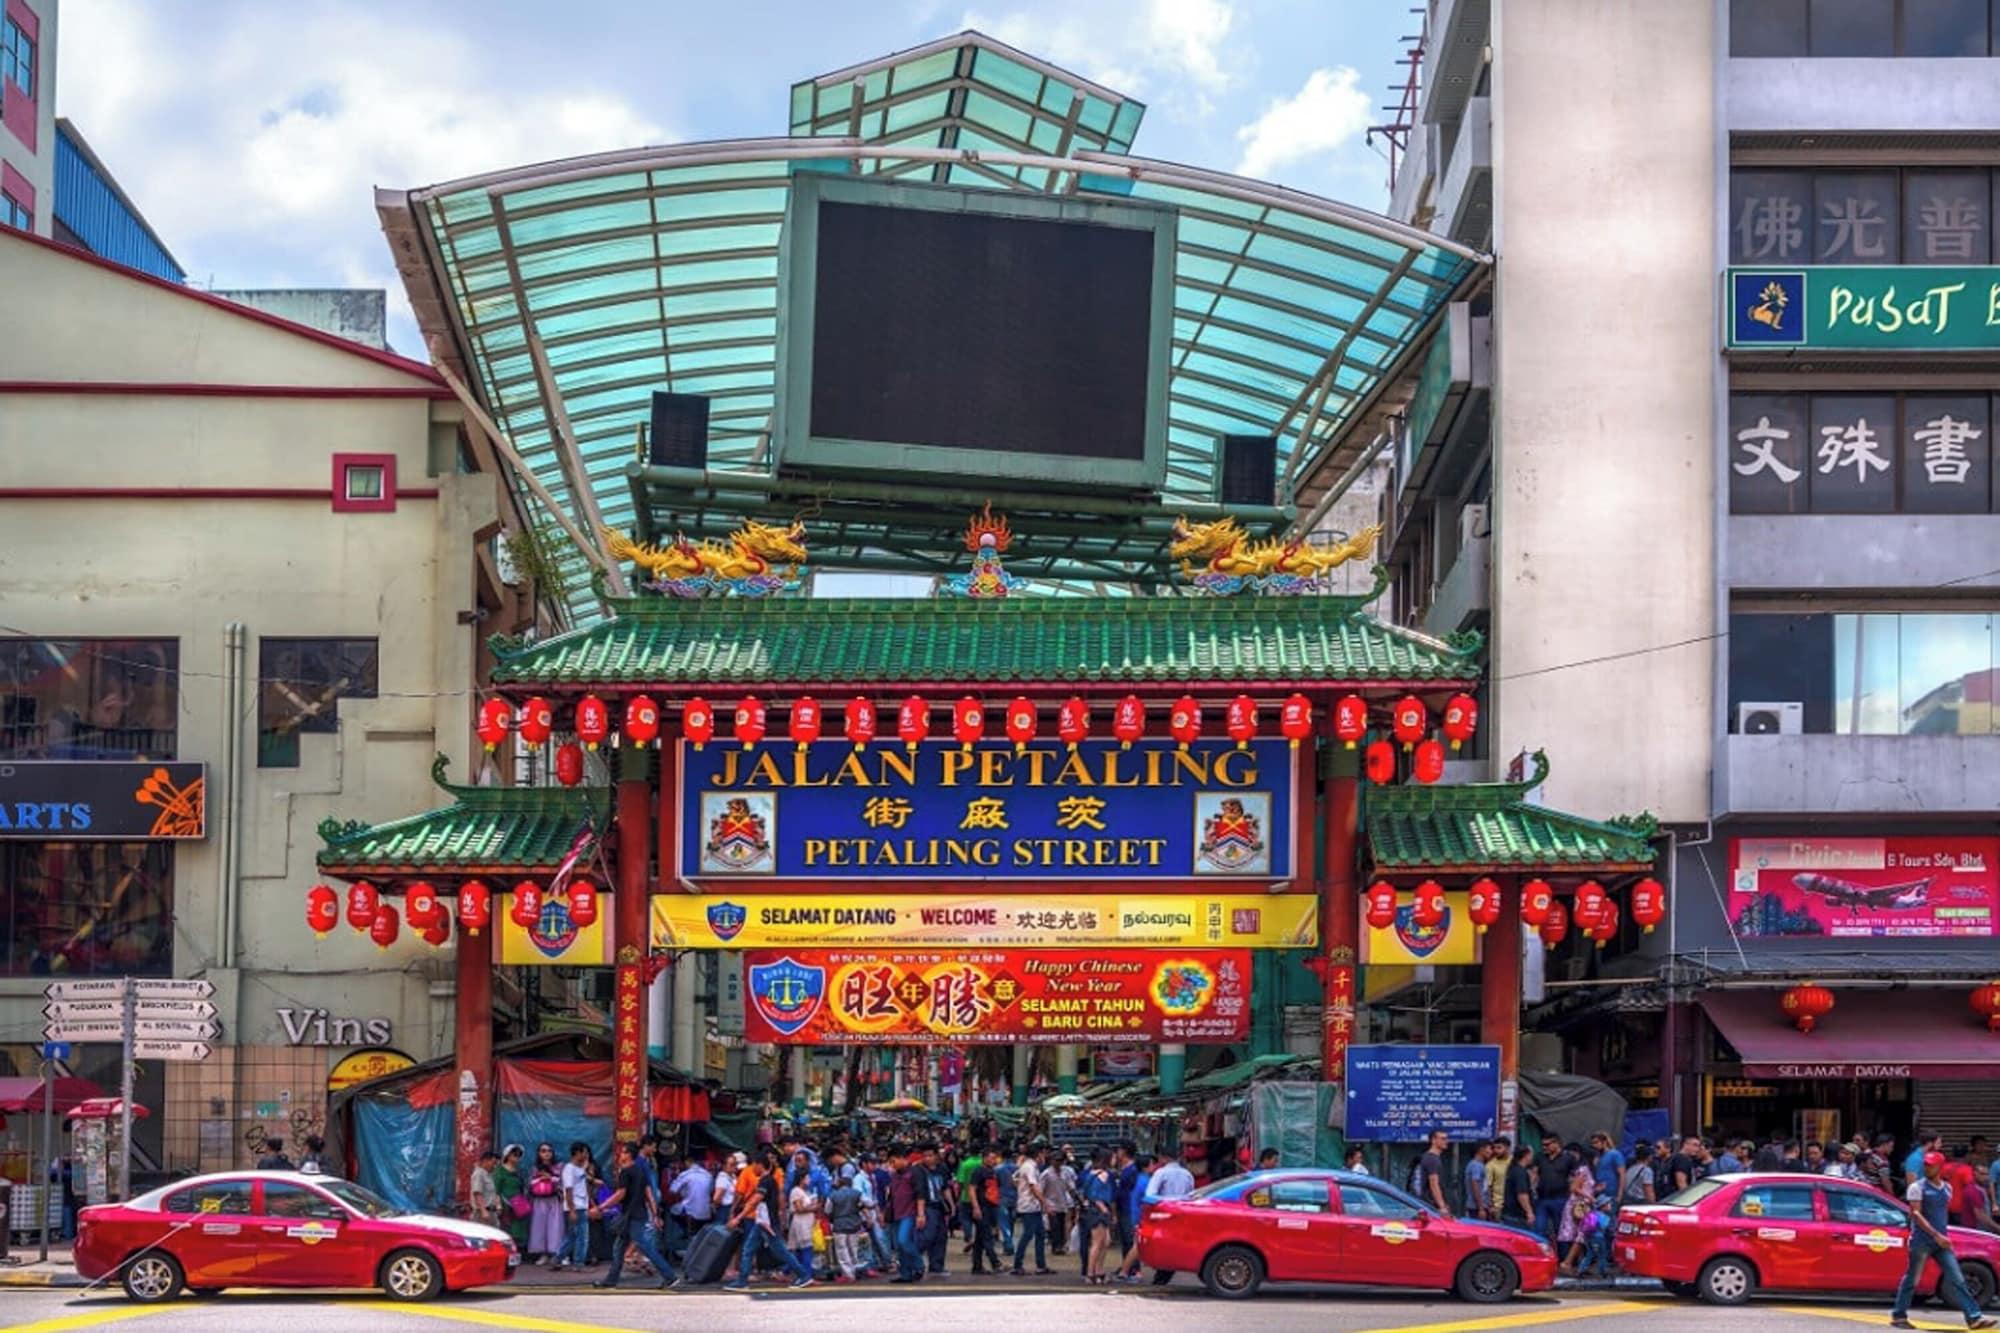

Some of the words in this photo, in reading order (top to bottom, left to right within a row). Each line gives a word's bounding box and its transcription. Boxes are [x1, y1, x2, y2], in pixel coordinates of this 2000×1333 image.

[1733, 415, 1983, 484] 文殊書
[711, 750, 919, 787] JALAN
[938, 749, 1260, 788] PETALING
[804, 838, 1001, 867] PETALING
[1013, 838, 1168, 867] STREET
[760, 908, 830, 925] SELAMAT
[834, 908, 896, 925] DATANG
[920, 908, 997, 925] WELCOME
[1016, 911, 1098, 930] 欢迎光临
[1024, 960, 1074, 975] Happy
[1079, 960, 1142, 974] Chinese
[1047, 979, 1084, 993] New
[1087, 979, 1122, 993] Year
[1021, 999, 1088, 1012] SELAMAT
[1093, 999, 1145, 1012] TAHUN
[276, 1008, 391, 1046] Vins
[1042, 1016, 1083, 1028] BARU
[1087, 1016, 1123, 1028] CINA
[1778, 1065, 1844, 1077] SELAMAT
[1855, 1065, 1911, 1077] DATANG
